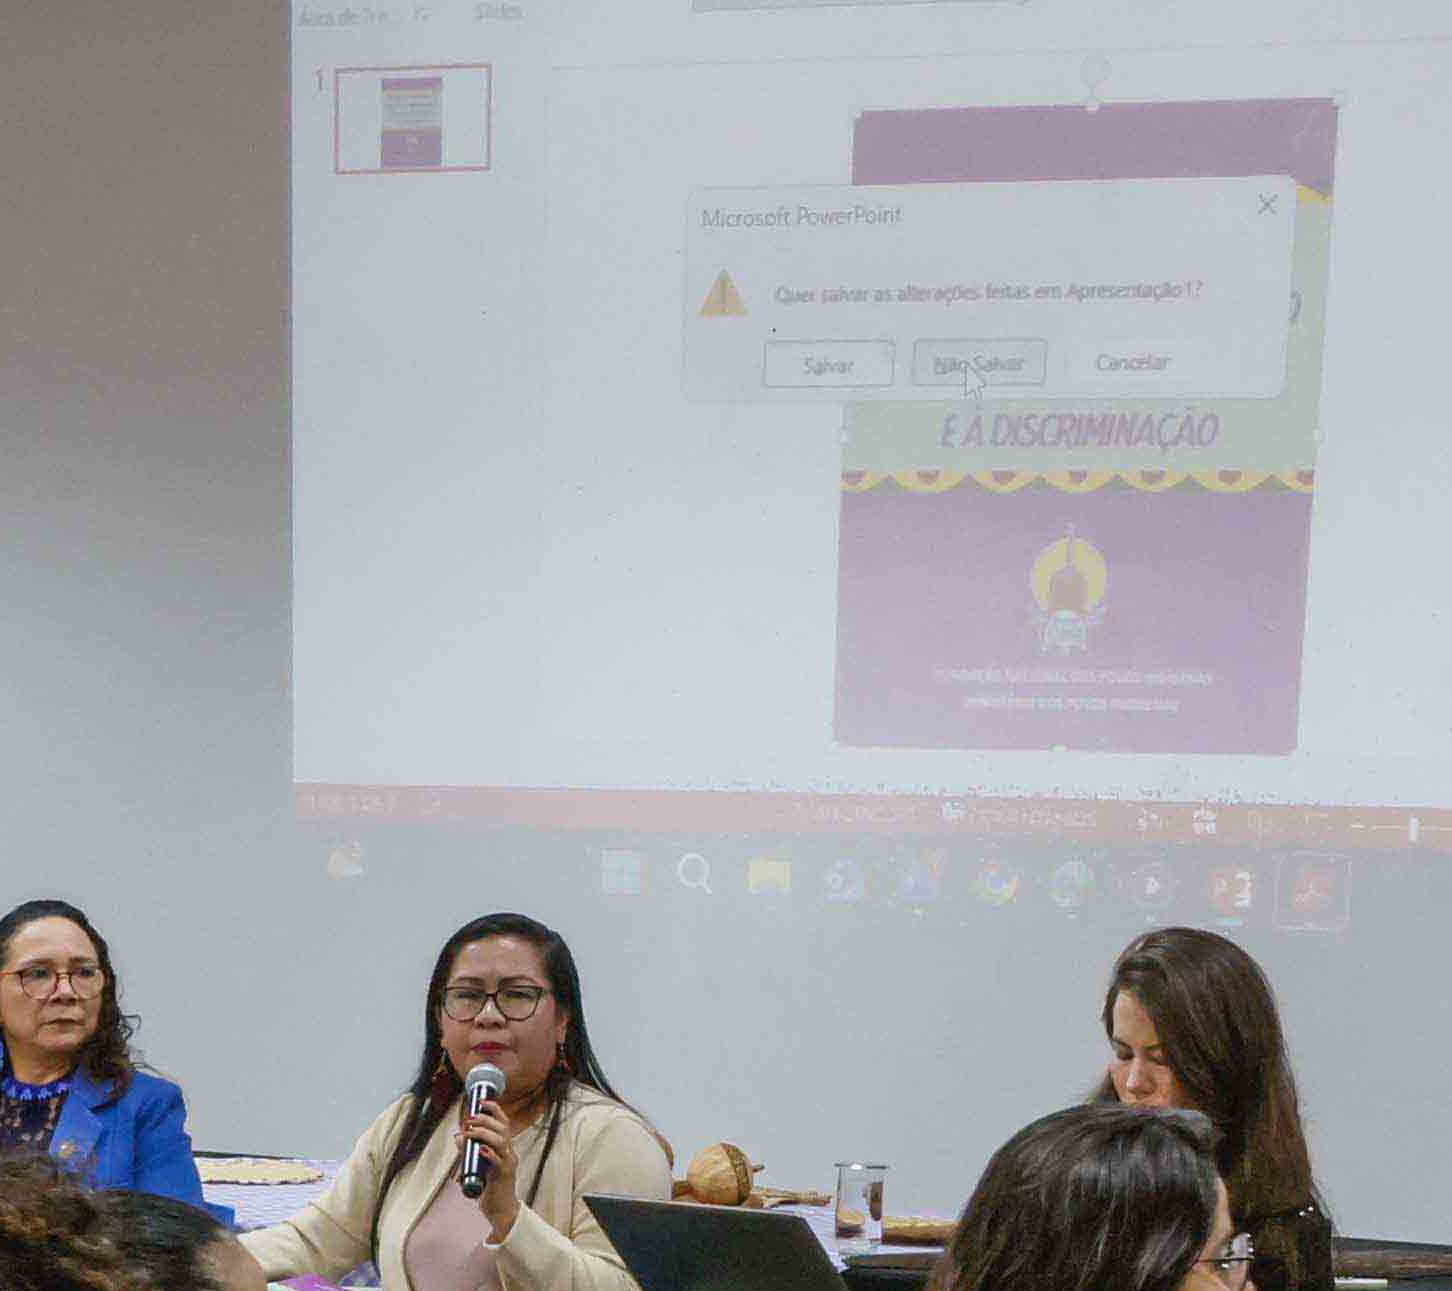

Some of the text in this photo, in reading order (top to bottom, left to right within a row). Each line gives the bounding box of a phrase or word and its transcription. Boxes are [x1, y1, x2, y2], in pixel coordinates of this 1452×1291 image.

[700, 203, 903, 228] Microsoft PowerPoint
[802, 356, 855, 376] Salvar
[1096, 353, 1172, 373] Cancelar
[938, 416, 959, 449] E
[989, 408, 1221, 455] DISCRIMINAÇÃO
